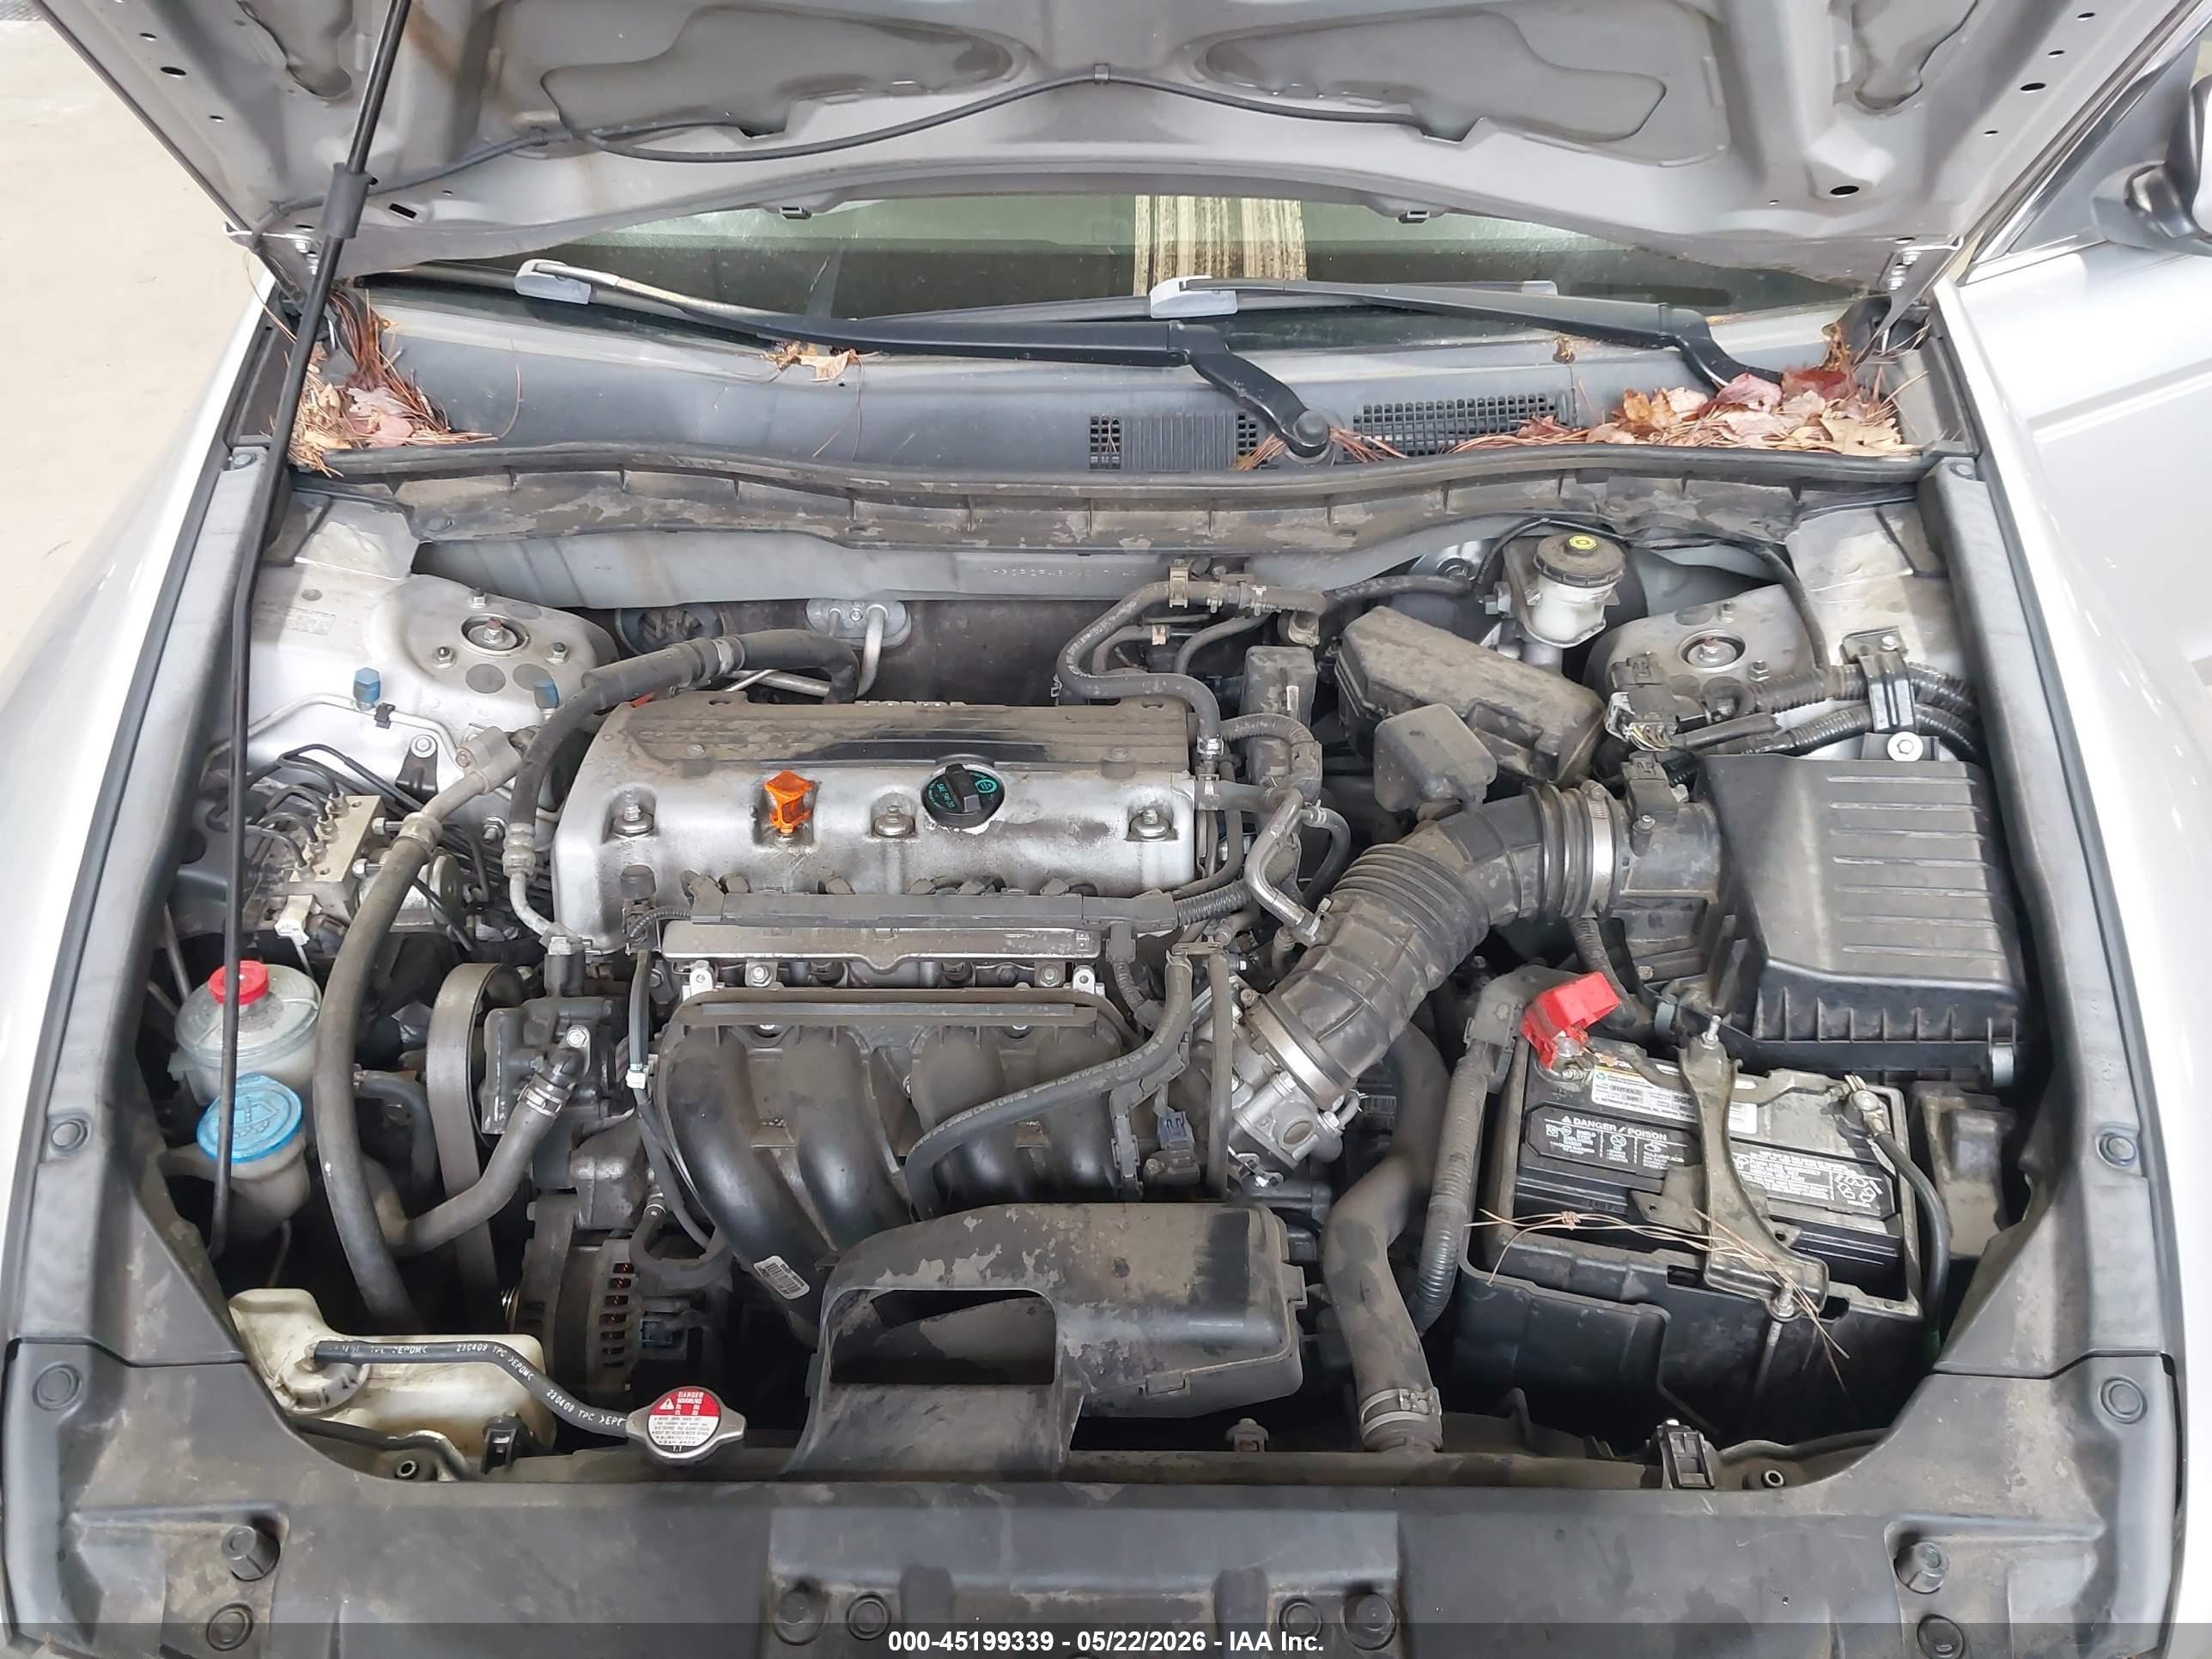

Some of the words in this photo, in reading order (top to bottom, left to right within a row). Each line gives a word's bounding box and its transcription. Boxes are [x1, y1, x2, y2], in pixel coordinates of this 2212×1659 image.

[1572, 1117, 1617, 1133] DANGER
[1627, 1127, 1668, 1141] POISON
[577, 1409, 595, 1422] TPC
